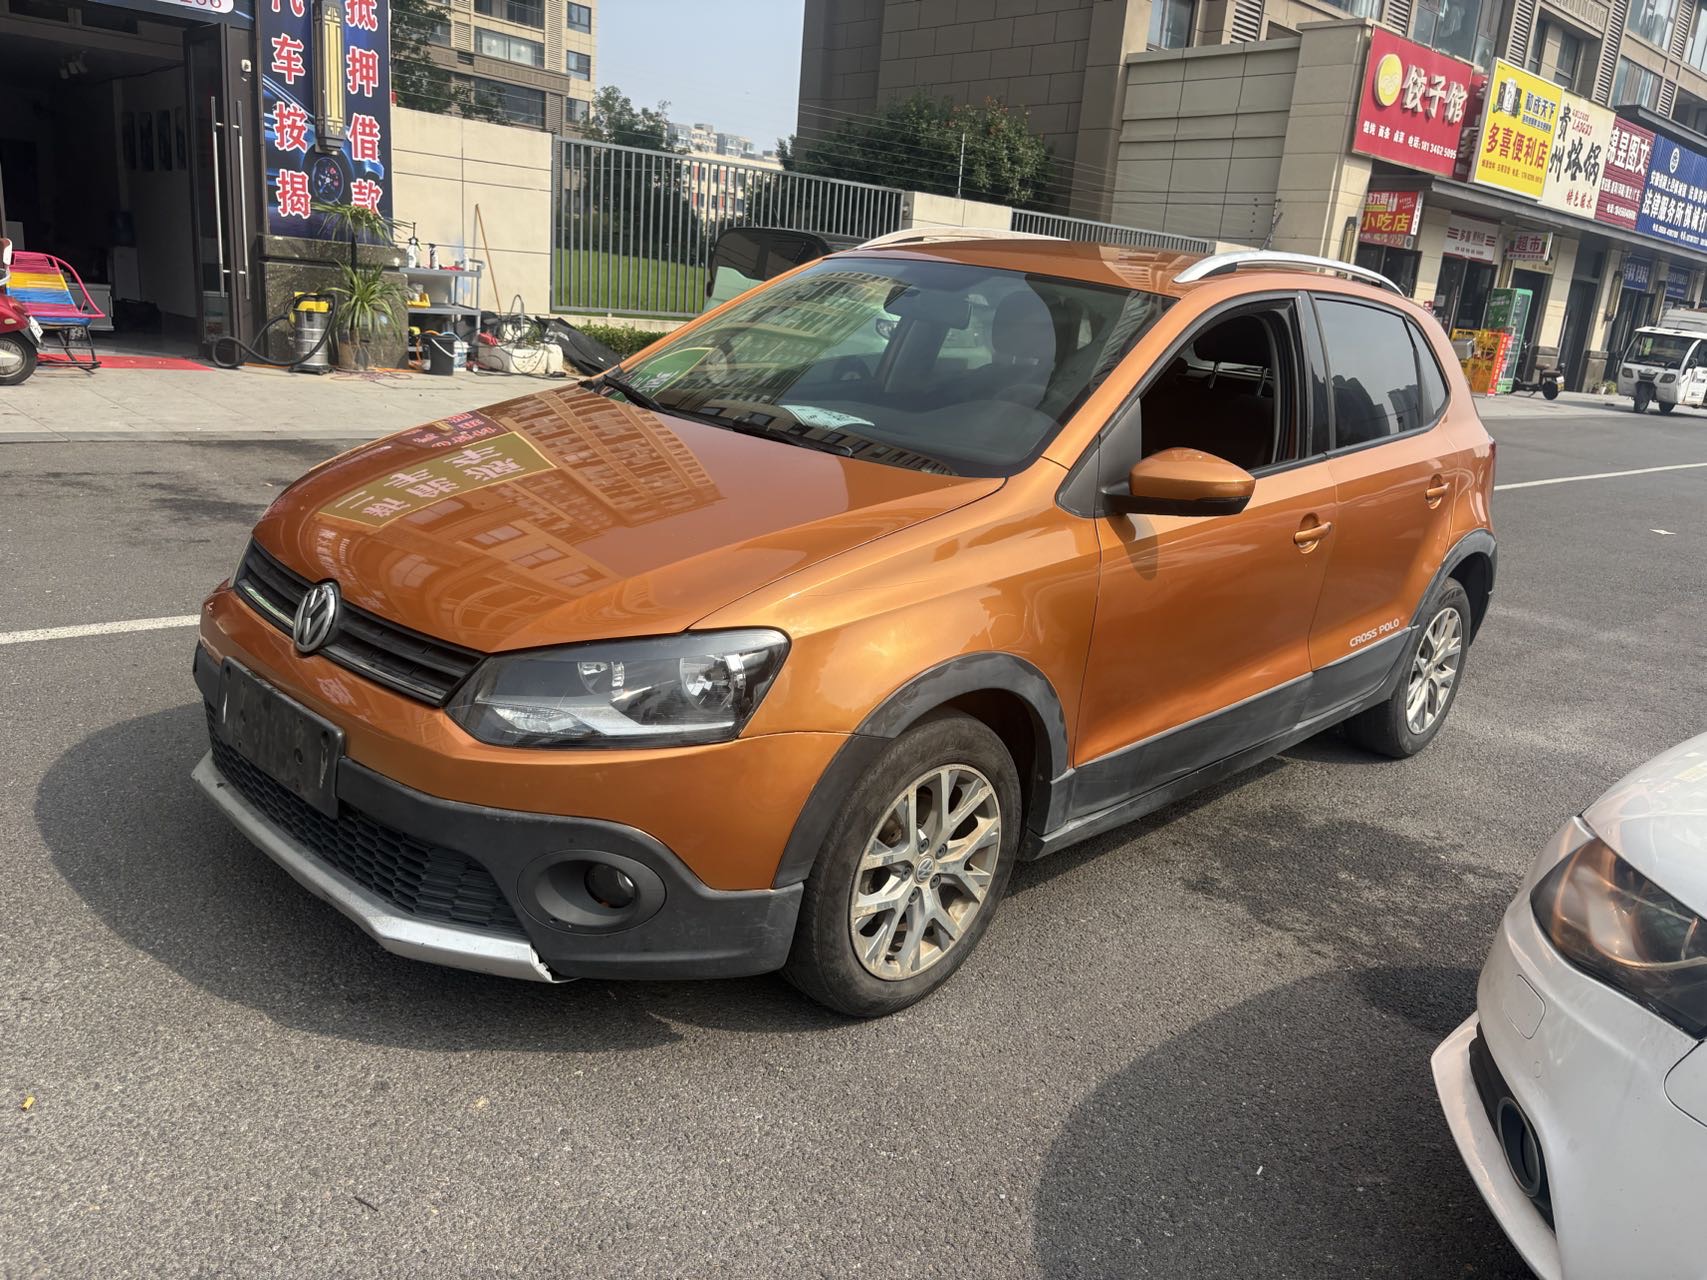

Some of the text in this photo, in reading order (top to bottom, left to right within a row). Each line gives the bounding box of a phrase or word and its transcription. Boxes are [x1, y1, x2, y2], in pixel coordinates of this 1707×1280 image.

[1402, 65, 1468, 123] 饺子馆
[1378, 125, 1390, 139] 面条
[1486, 122, 1548, 170] 多喜便利店
[1362, 212, 1411, 232] 小吃店
[1515, 235, 1542, 252] 超市
[1349, 618, 1400, 647] CROSS POLO
